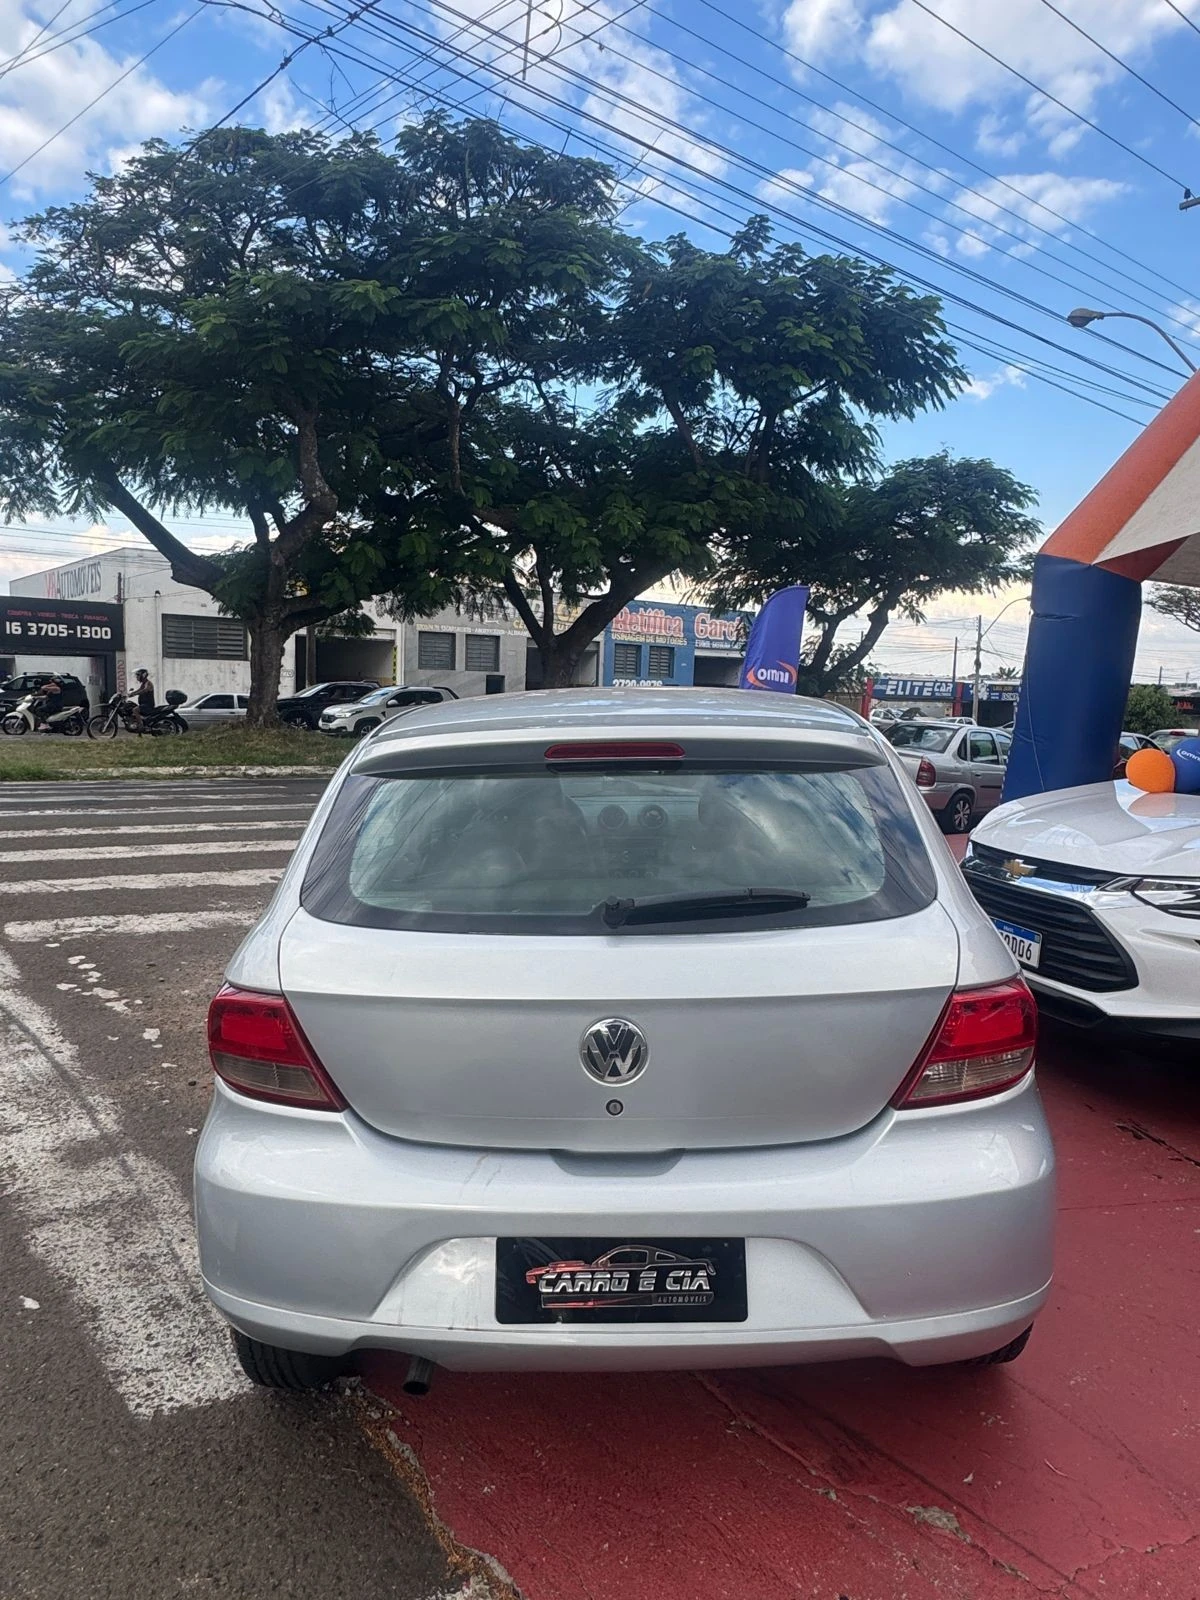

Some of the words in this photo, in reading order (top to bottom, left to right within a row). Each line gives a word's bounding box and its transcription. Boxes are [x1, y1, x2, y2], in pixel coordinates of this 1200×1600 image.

[5, 621, 22, 635] 16
[27, 622, 112, 640] 3705-1300
[885, 680, 934, 696] ELITE
[934, 682, 953, 693] CAR
[638, 1271, 657, 1291] E
